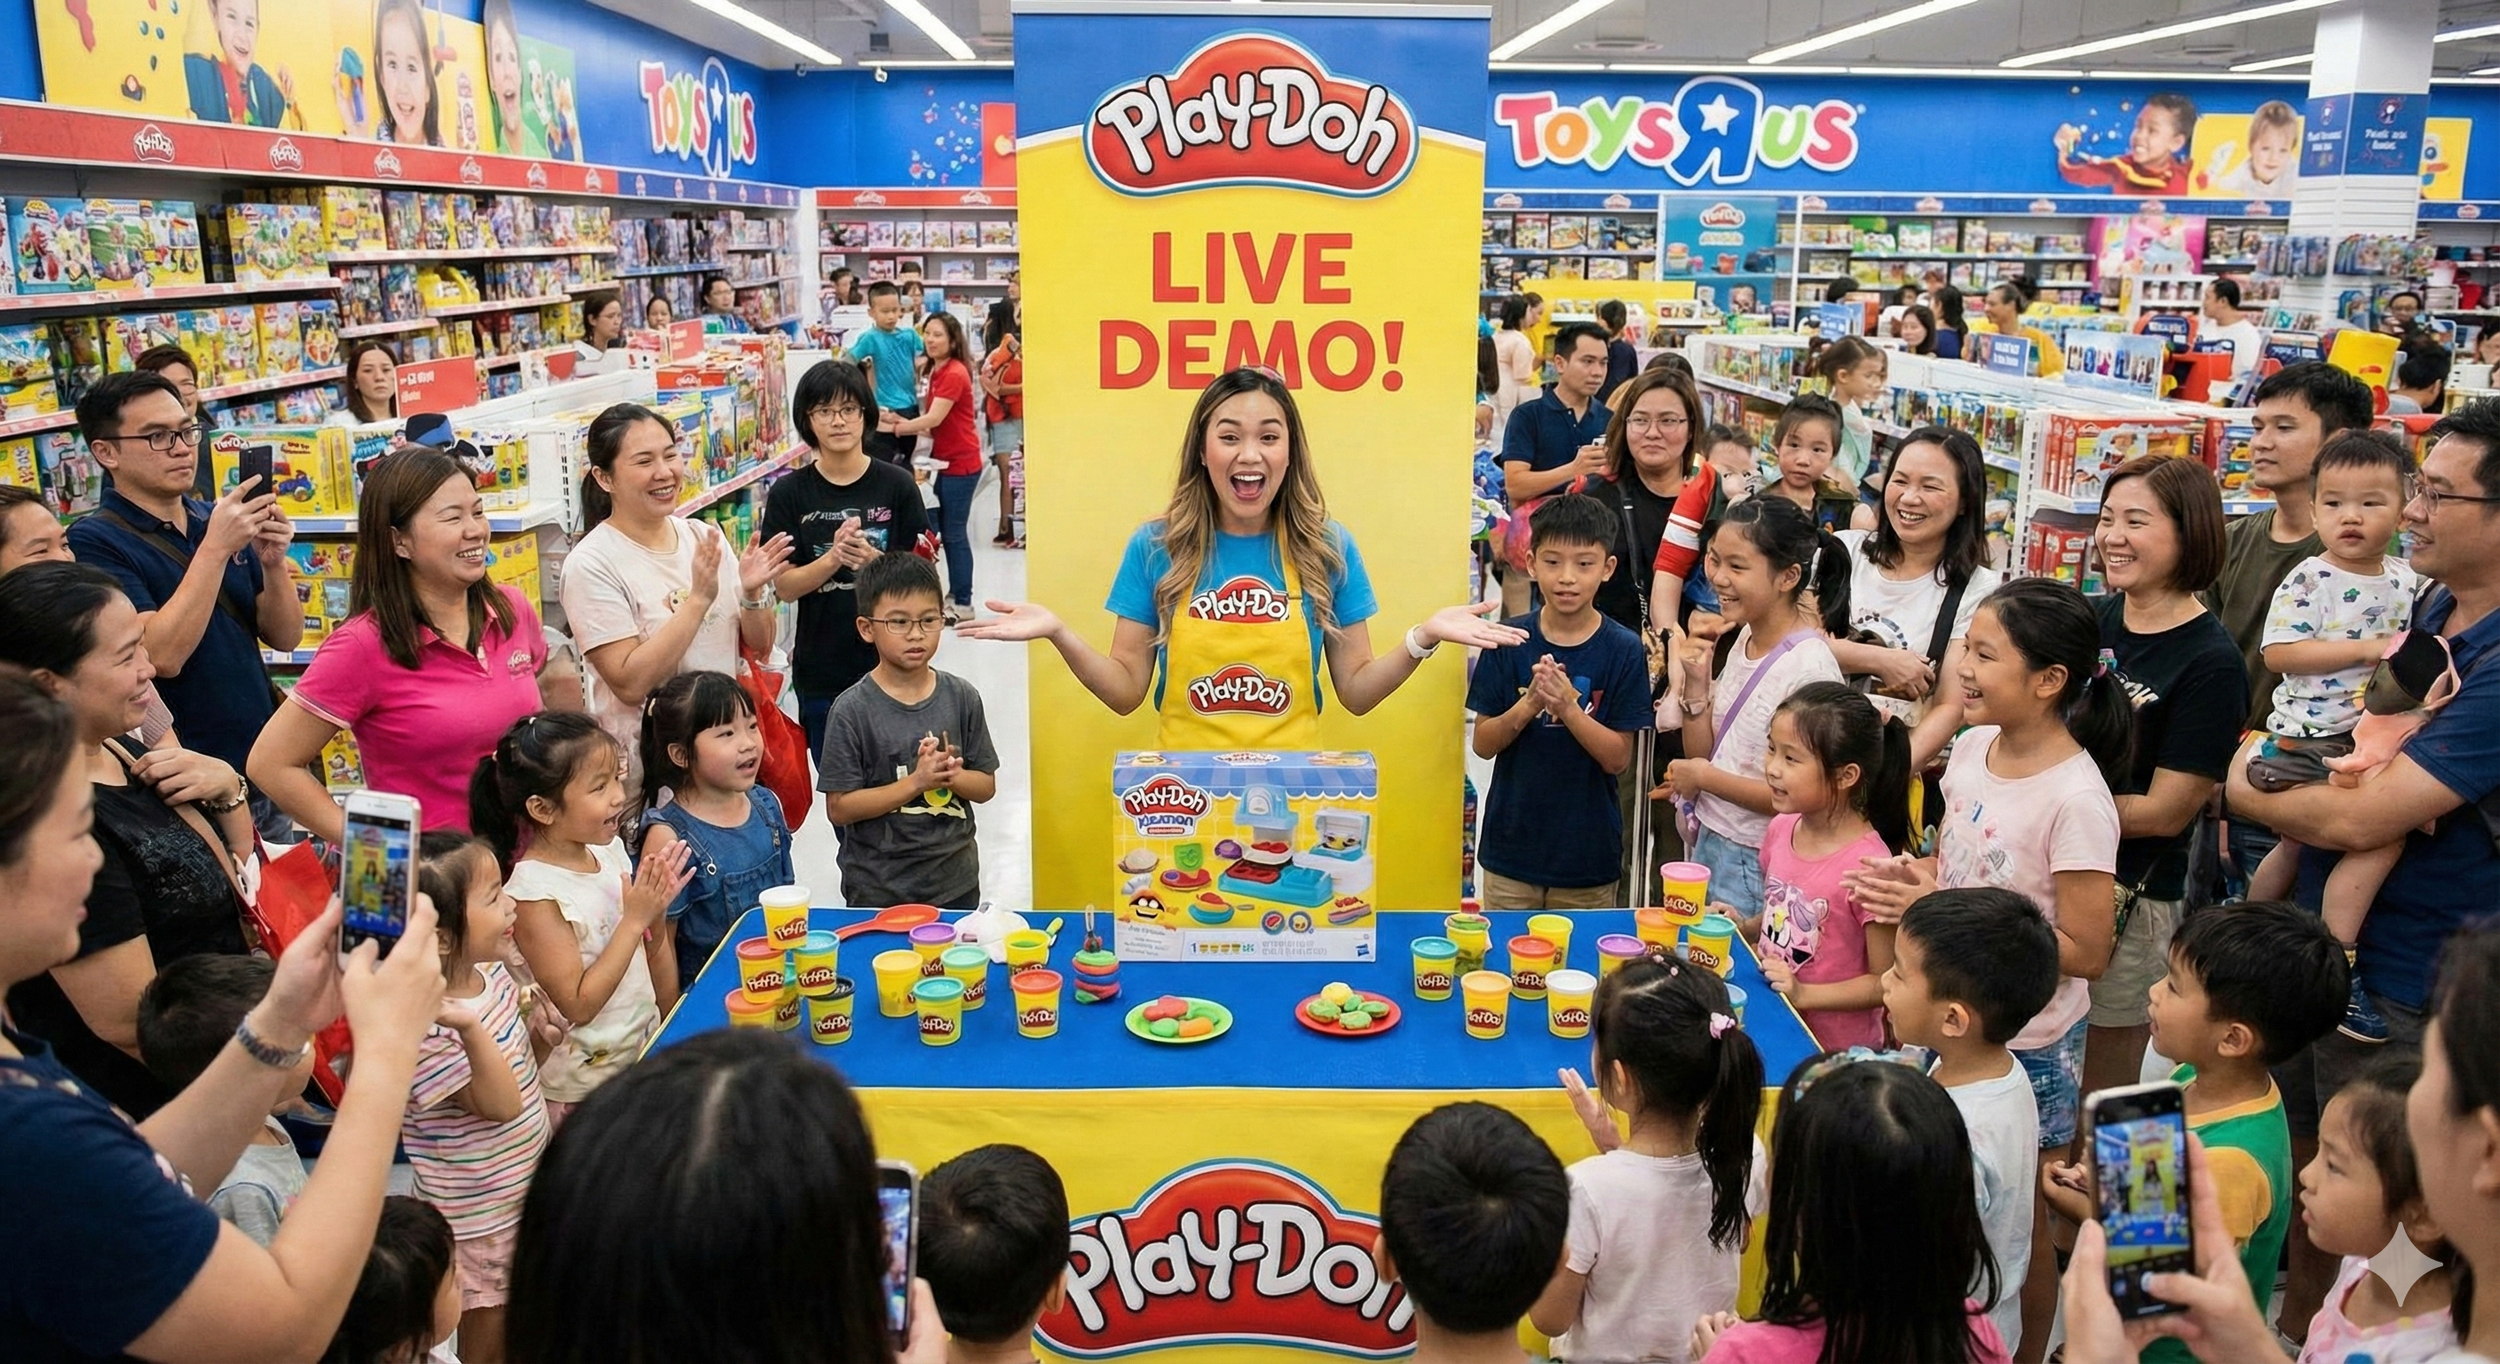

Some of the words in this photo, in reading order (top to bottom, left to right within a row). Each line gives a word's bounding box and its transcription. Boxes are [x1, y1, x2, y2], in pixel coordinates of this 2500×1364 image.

[1096, 67, 1398, 176] Play-Doh
[1152, 231, 1353, 304] LIVE
[1100, 319, 1405, 392] DEMO!
[1191, 588, 1290, 622] Play-Do
[1189, 675, 1288, 709] Play-Doh
